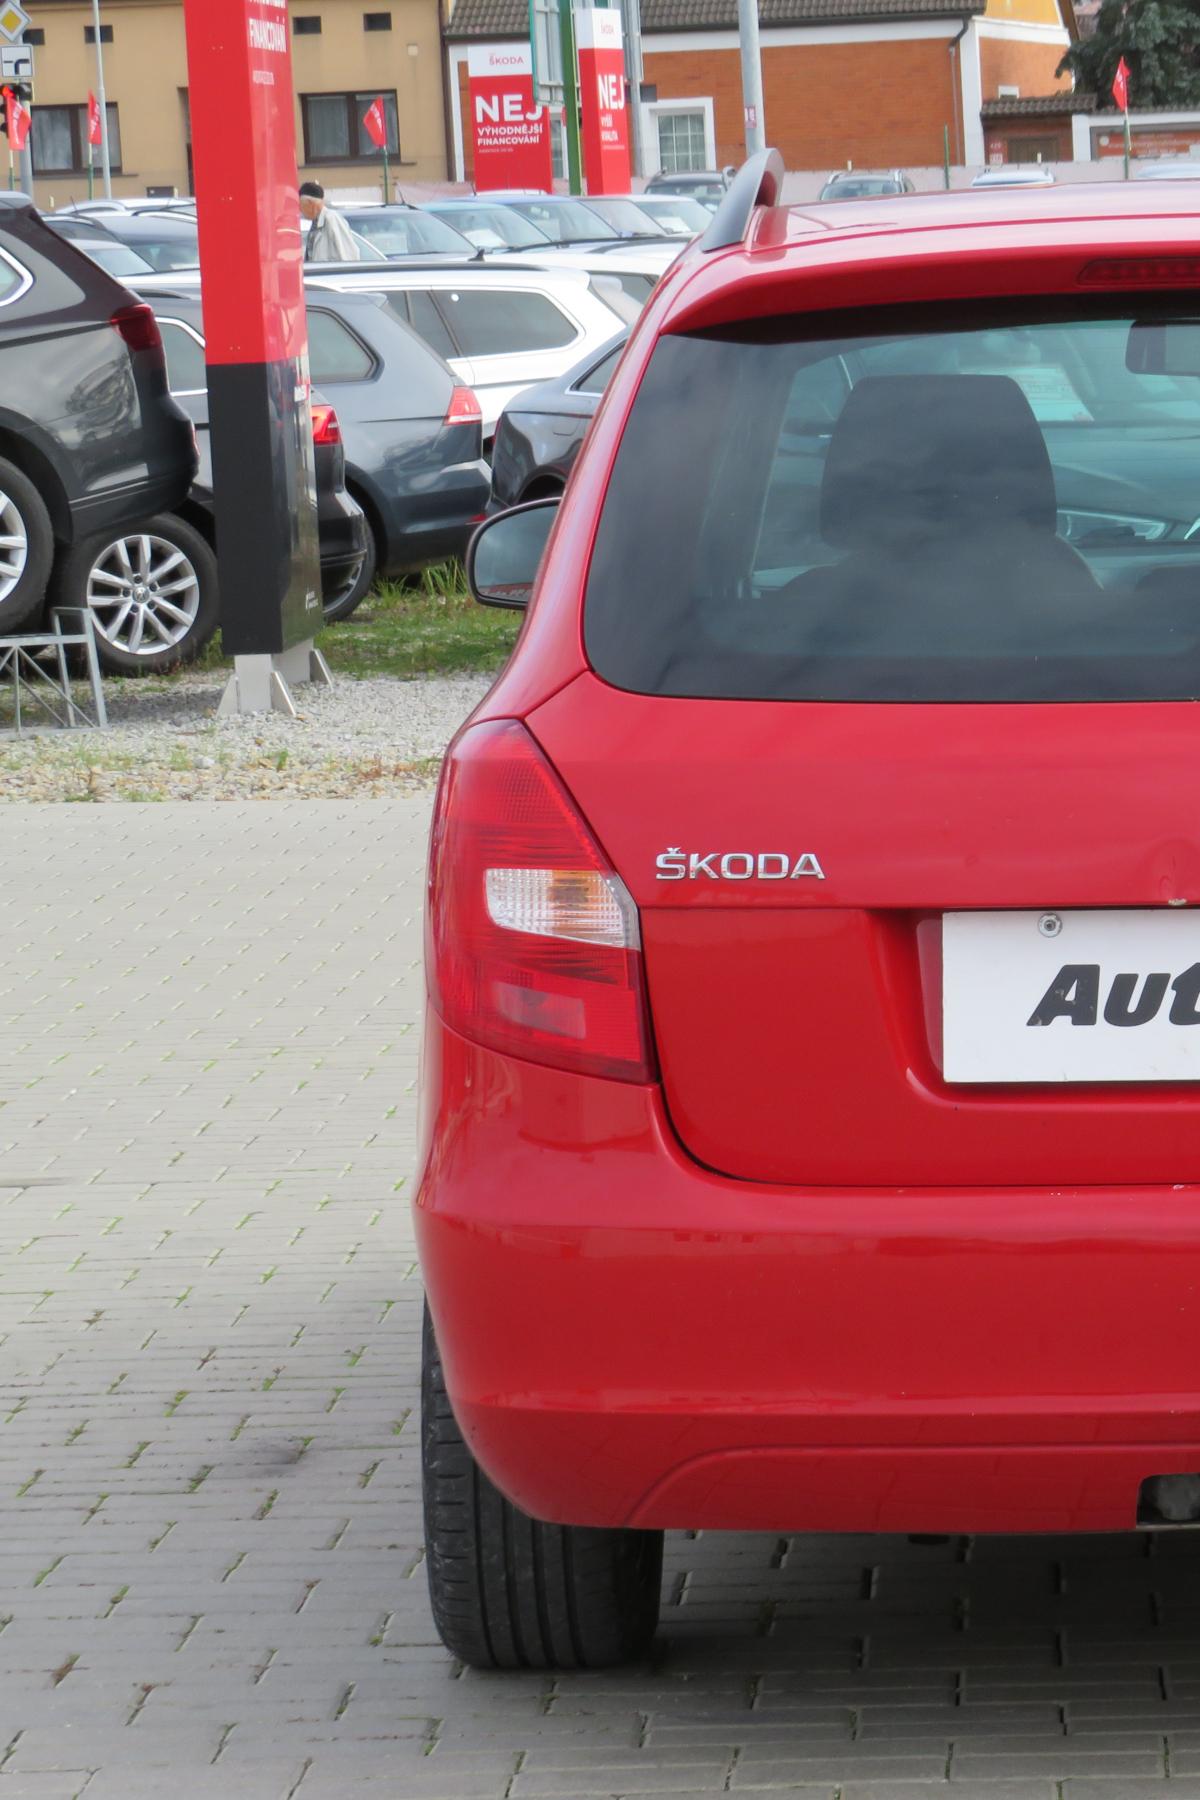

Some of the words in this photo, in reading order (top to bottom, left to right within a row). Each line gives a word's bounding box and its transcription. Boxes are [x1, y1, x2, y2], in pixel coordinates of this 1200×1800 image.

[489, 53, 524, 66] ŠKODA
[598, 74, 625, 110] NEJ
[475, 93, 543, 123] NEJ
[477, 123, 543, 137] VÝHODNĚJŠÍ
[477, 135, 540, 146] FINANCOVÁNÍ
[655, 847, 826, 880] ŠKODA
